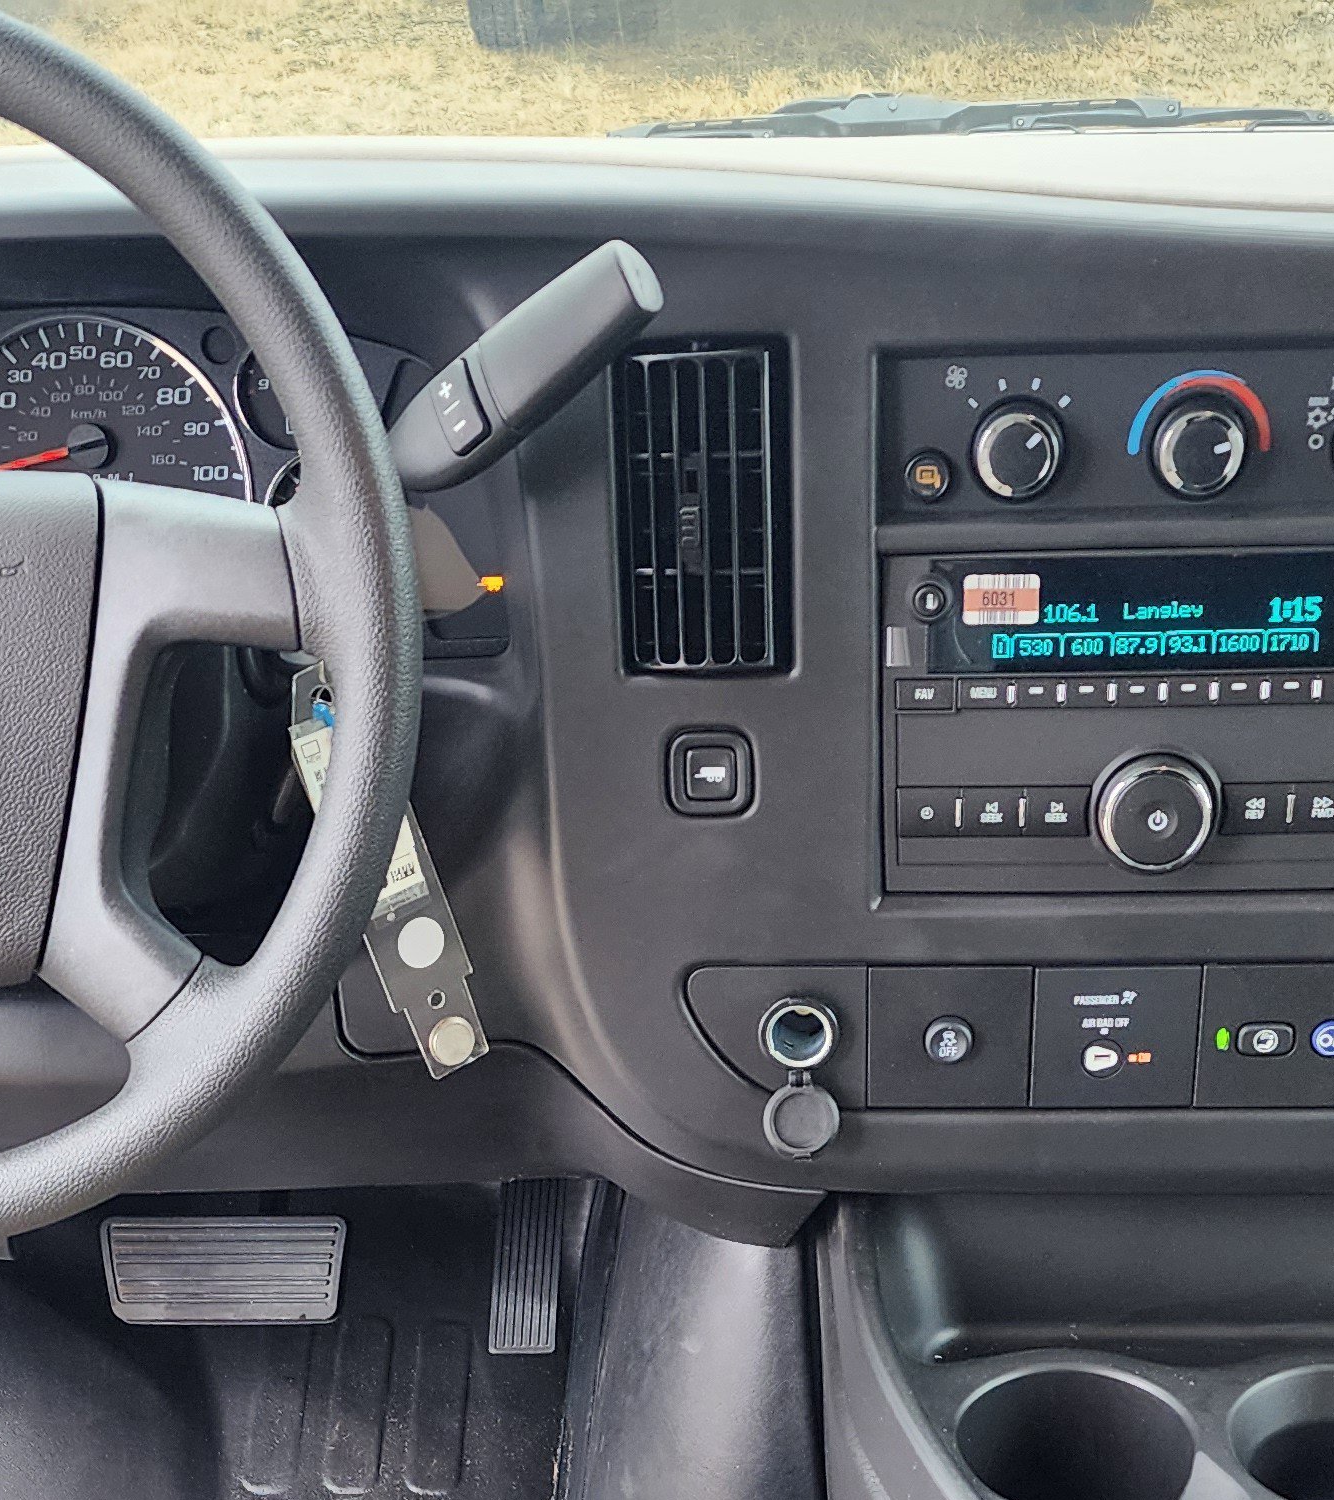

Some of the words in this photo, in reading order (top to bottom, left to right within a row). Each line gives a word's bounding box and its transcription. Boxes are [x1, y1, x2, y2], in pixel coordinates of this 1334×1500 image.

[69, 345, 97, 360] 50
[31, 351, 67, 370] 40
[100, 351, 133, 369] 60
[7, 369, 33, 383] 30
[137, 366, 160, 379] 70
[50, 392, 71, 403] 60
[98, 390, 123, 401] 100
[156, 387, 191, 405] 80
[30, 406, 51, 418] 40
[71, 409, 107, 420] km/h
[122, 405, 145, 416] 120
[137, 425, 162, 437] 140
[184, 422, 209, 436] 90
[17, 431, 38, 442] 20
[151, 455, 176, 465] 160
[192, 466, 228, 482] 100
[982, 591, 1015, 606] 6031
[1043, 603, 1099, 623] 106.1
[1268, 596, 1323, 623] 1:15
[1019, 639, 1053, 656] 530
[1071, 638, 1104, 656] 600
[1116, 637, 1158, 654] 87.9
[1168, 635, 1207, 653] 93.1
[1219, 634, 1260, 652] 1600
[1270, 634, 1310, 652] 1710
[939, 1046, 958, 1057] OFF
